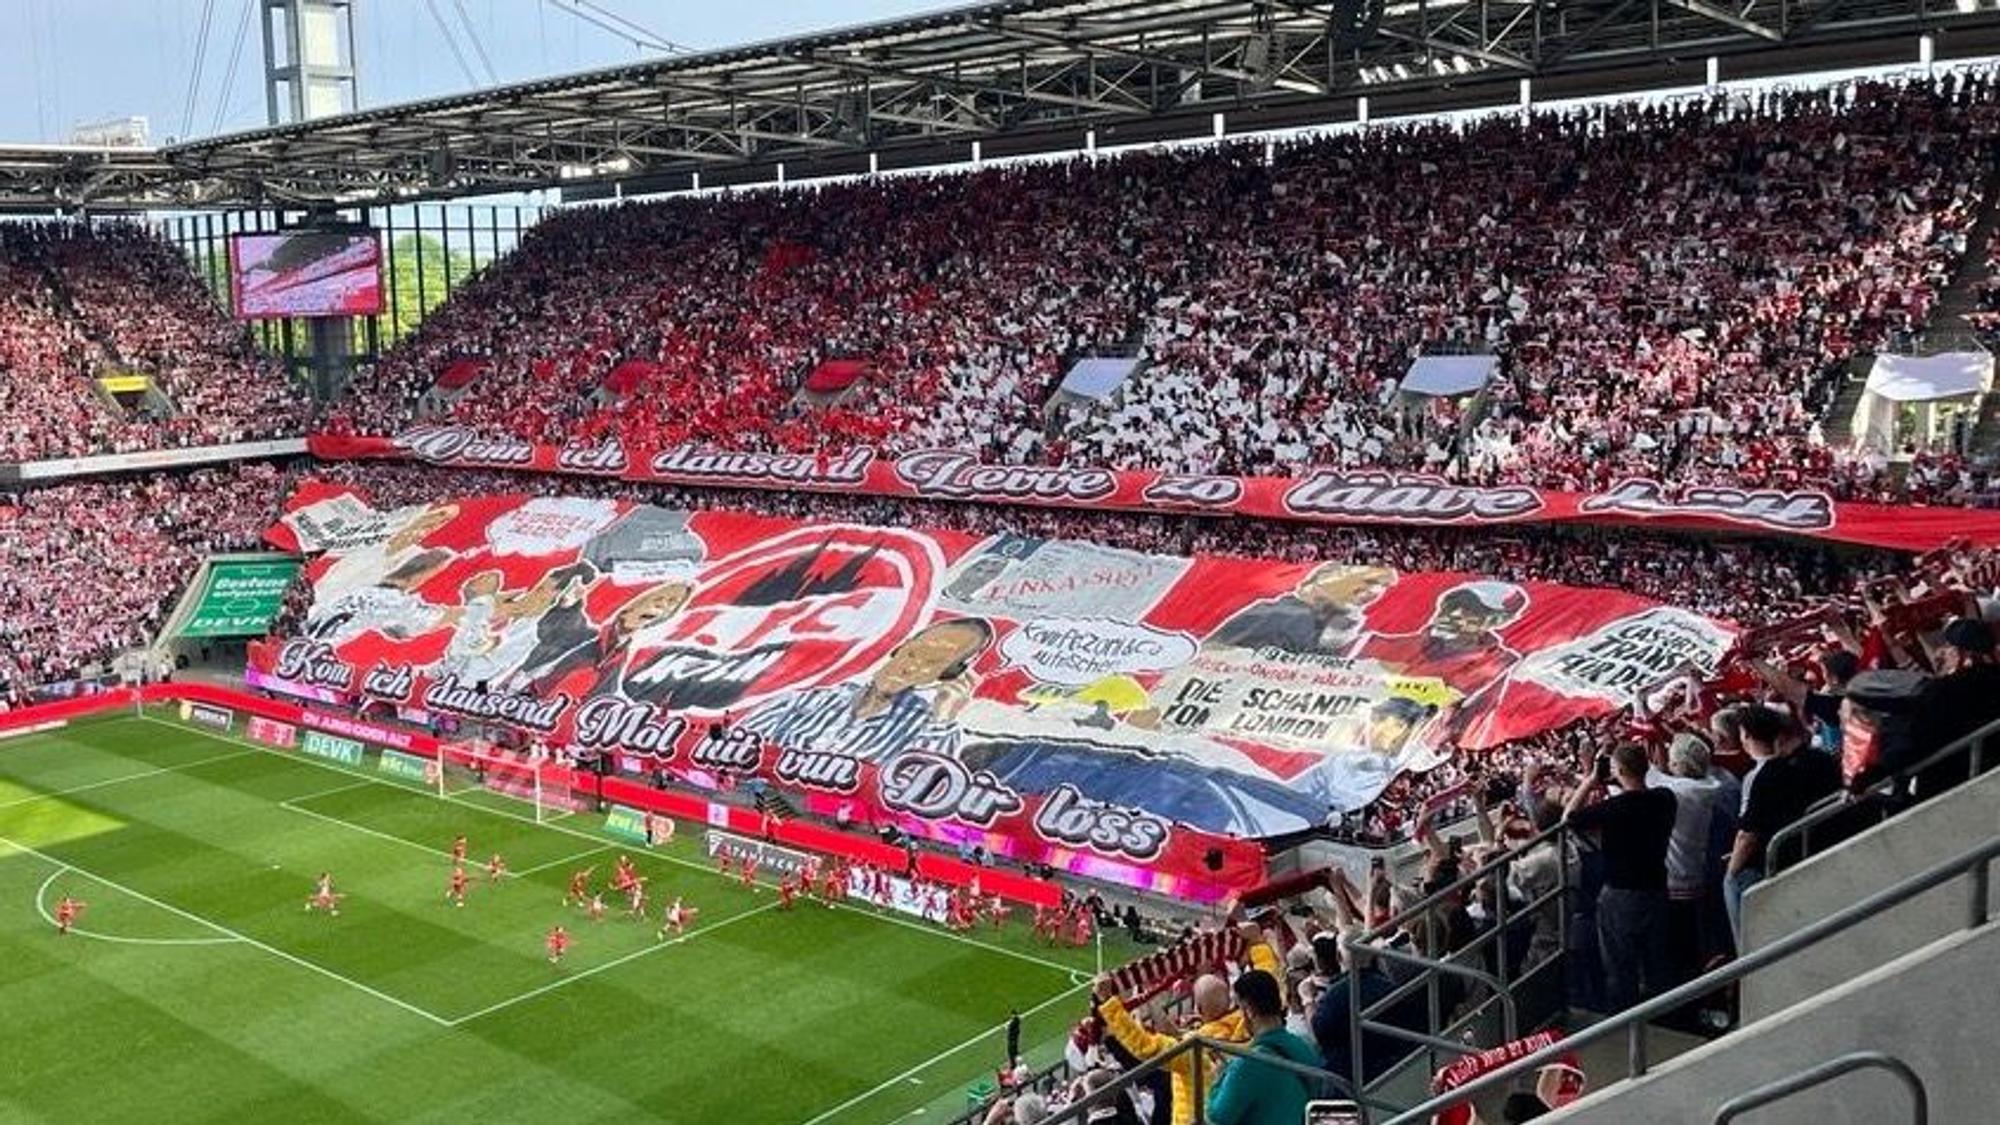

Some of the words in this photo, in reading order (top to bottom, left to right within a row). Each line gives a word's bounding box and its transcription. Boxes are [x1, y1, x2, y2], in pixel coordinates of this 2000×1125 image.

[558, 437, 627, 471] ich
[652, 443, 875, 483] dausend
[1144, 477, 1241, 504] zo
[1587, 634, 1685, 674] TRANS
[1229, 712, 1331, 740] LONDON
[309, 735, 353, 763] DEVK
[363, 663, 411, 699] ich
[426, 676, 568, 729] dausend
[884, 752, 1022, 824] Dir
[1036, 785, 1168, 859] loss
